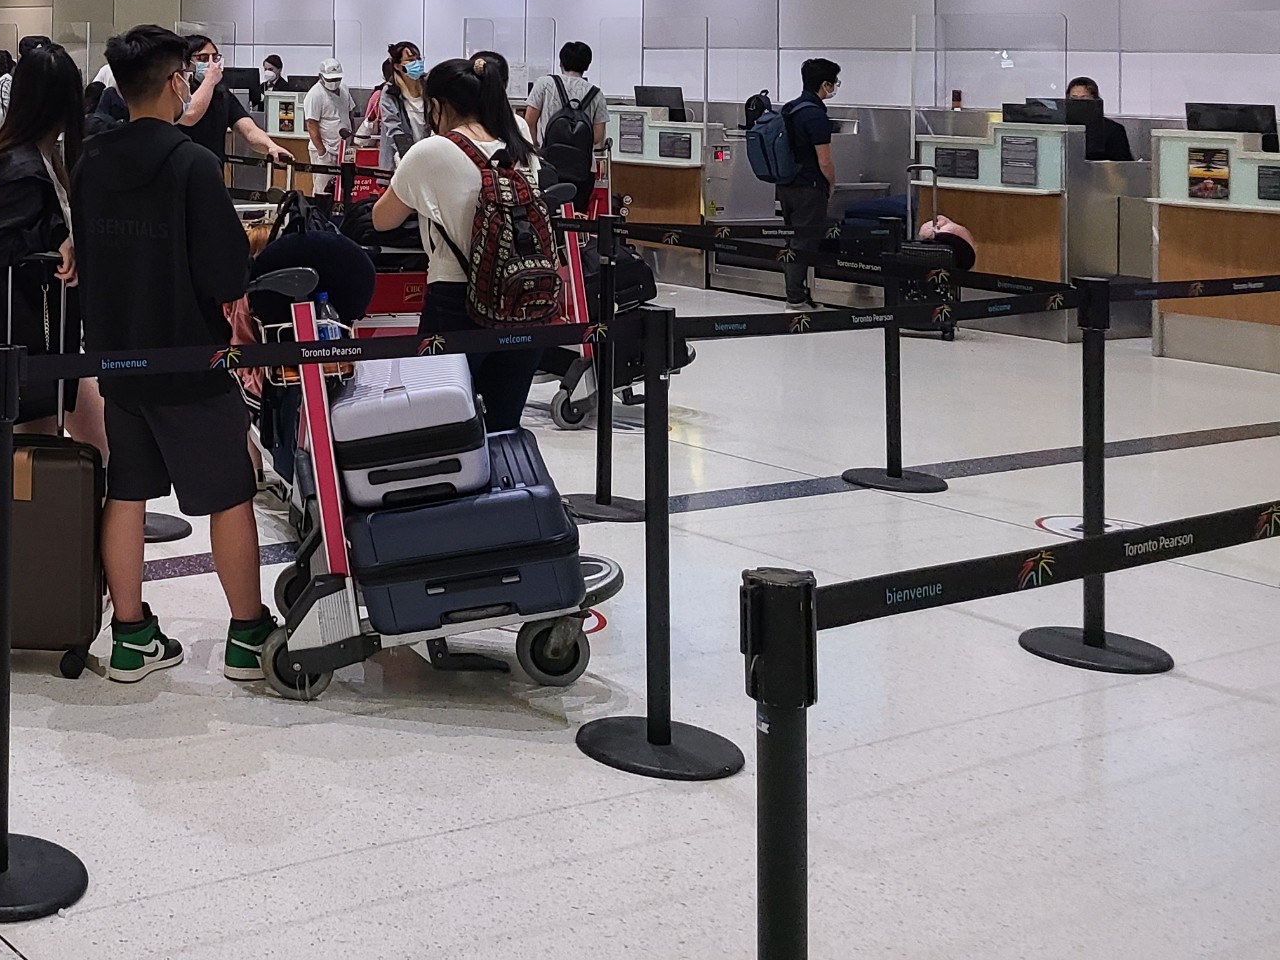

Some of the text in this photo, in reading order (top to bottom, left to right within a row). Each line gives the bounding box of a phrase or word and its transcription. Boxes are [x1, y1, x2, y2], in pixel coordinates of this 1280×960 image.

[836, 259, 882, 272] Toronto Pearson
[405, 284, 423, 294] CIBC
[851, 313, 894, 324] Toronto Pearson
[714, 321, 748, 331] bienvenue
[498, 334, 532, 345] welcome
[301, 346, 362, 358] Toronto Pearson
[101, 358, 148, 370] bienvenue
[1123, 533, 1194, 558] Toronto Pearson
[885, 581, 943, 605] bienvenue
